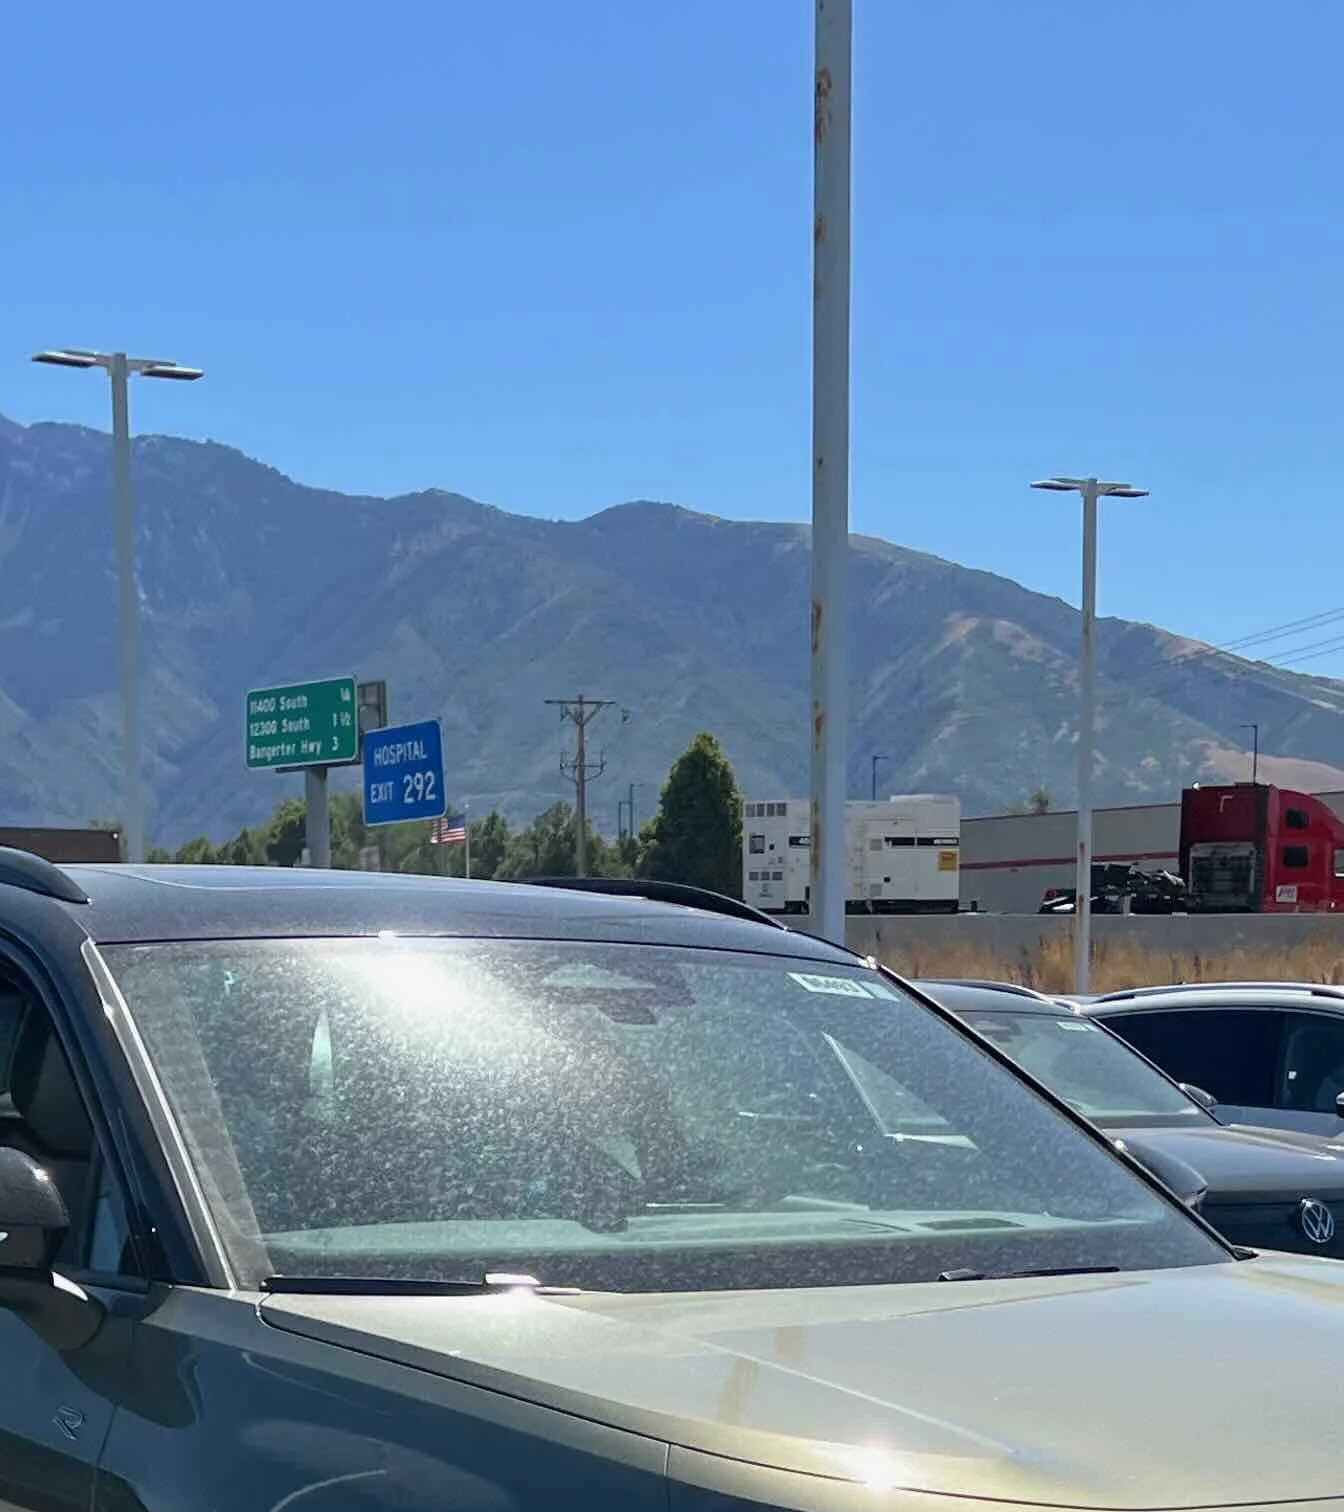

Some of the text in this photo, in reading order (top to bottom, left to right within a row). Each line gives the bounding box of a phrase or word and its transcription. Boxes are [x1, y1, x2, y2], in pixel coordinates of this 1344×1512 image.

[249, 697, 276, 715] 11400
[280, 694, 309, 711] South
[249, 720, 278, 737] 12300
[281, 717, 310, 733] South
[249, 736, 340, 762] Bangerter Hwy 3
[373, 740, 428, 766] HOSPITAL
[370, 770, 437, 804] EXIT 292
